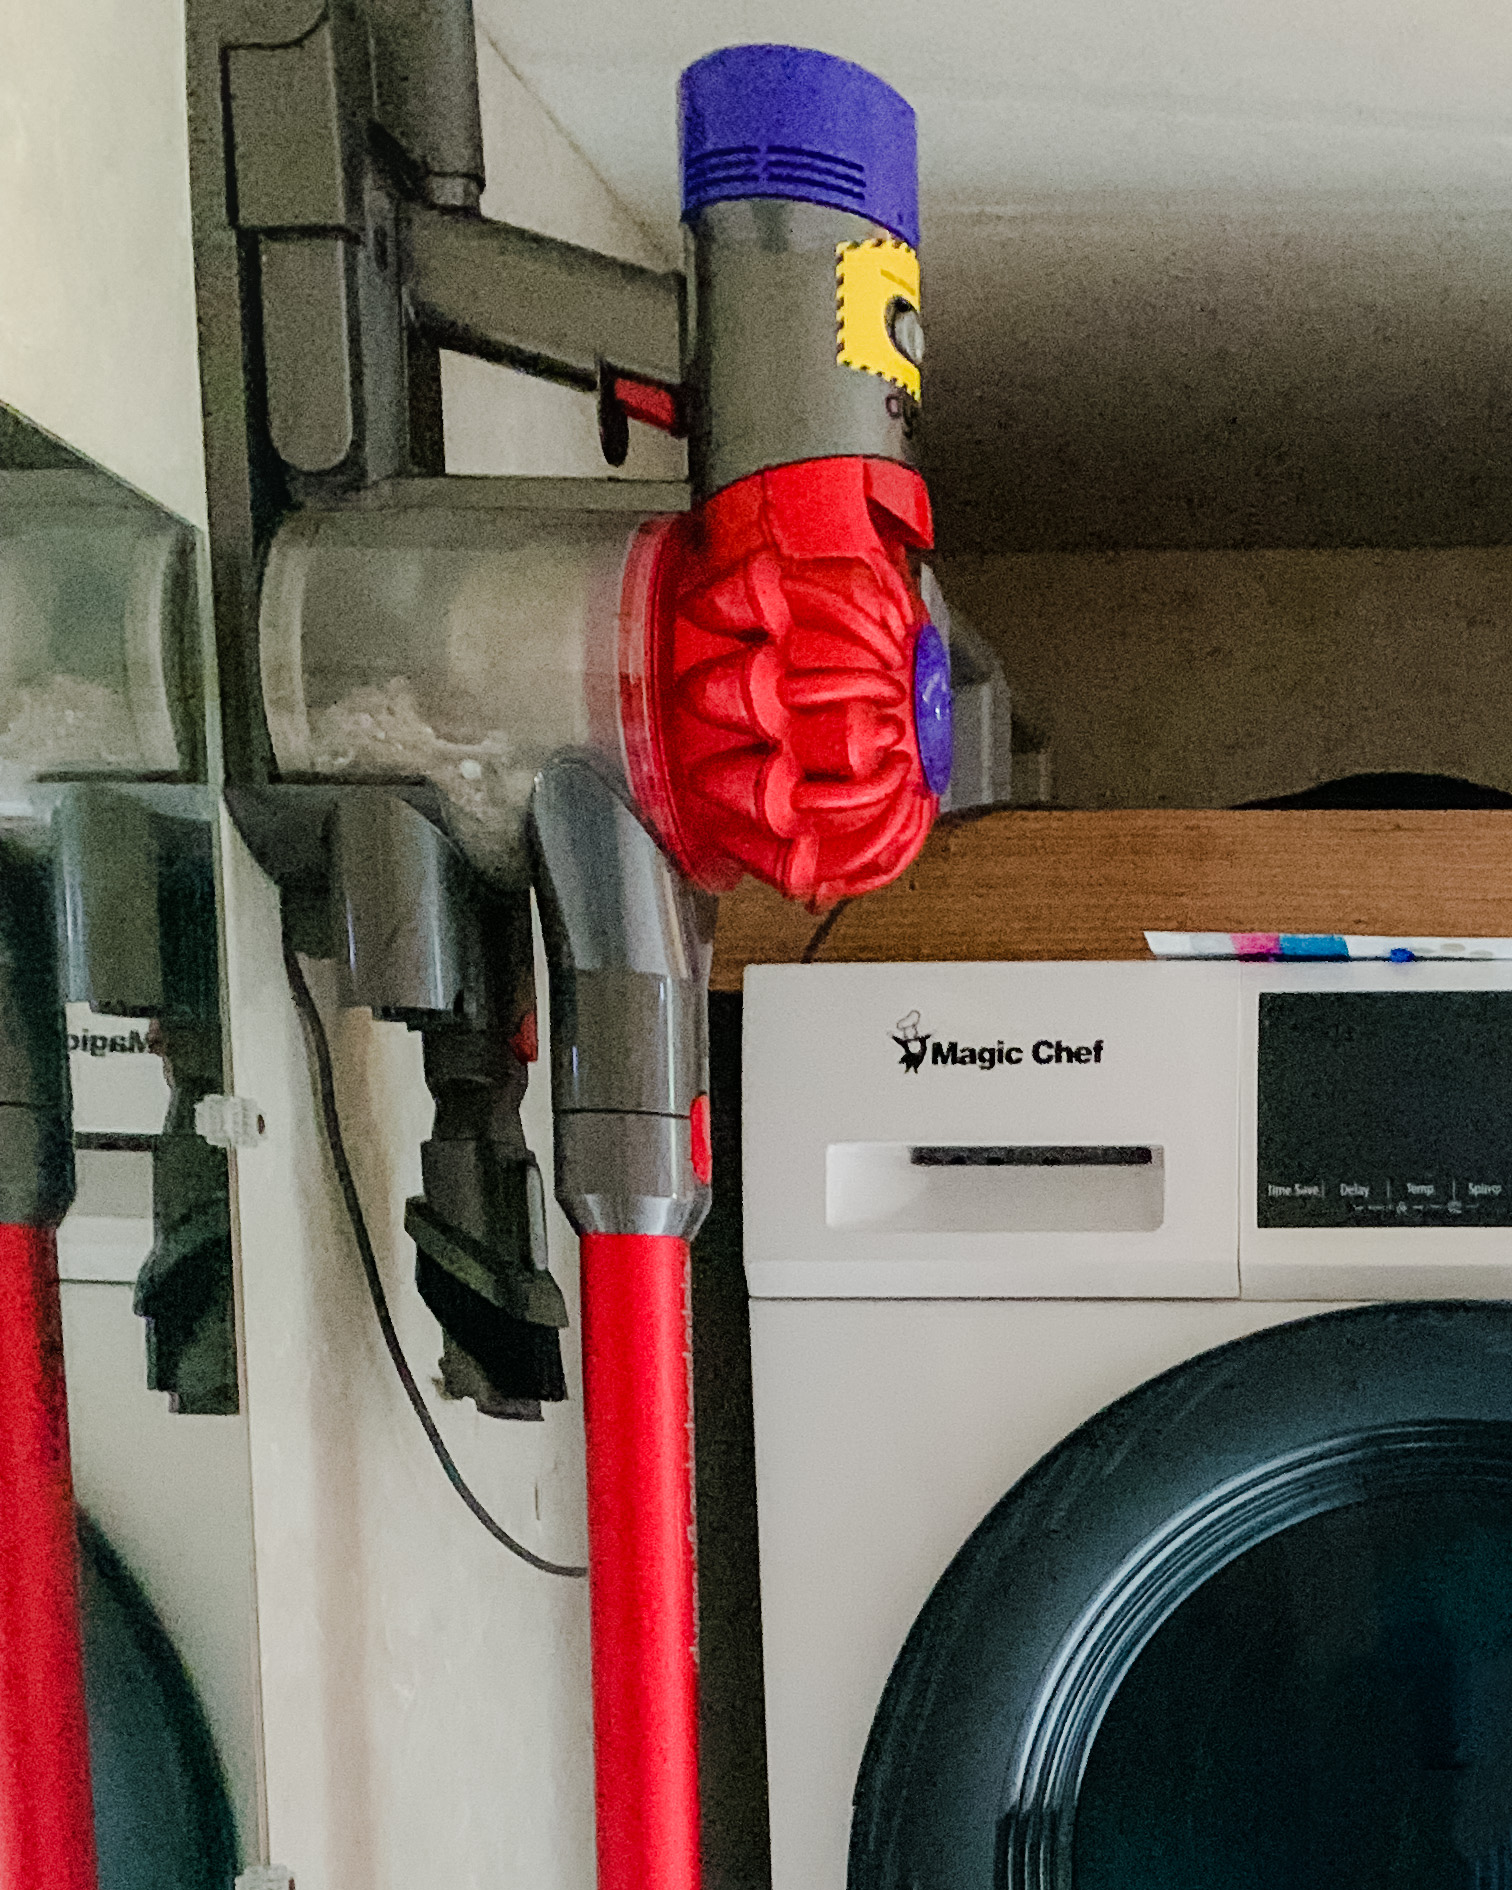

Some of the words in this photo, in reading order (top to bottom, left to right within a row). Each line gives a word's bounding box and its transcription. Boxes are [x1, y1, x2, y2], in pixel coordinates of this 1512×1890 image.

[931, 1040, 1024, 1070] Magic
[1031, 1039, 1105, 1065] Chef
[1339, 1182, 1370, 1198] Delay
